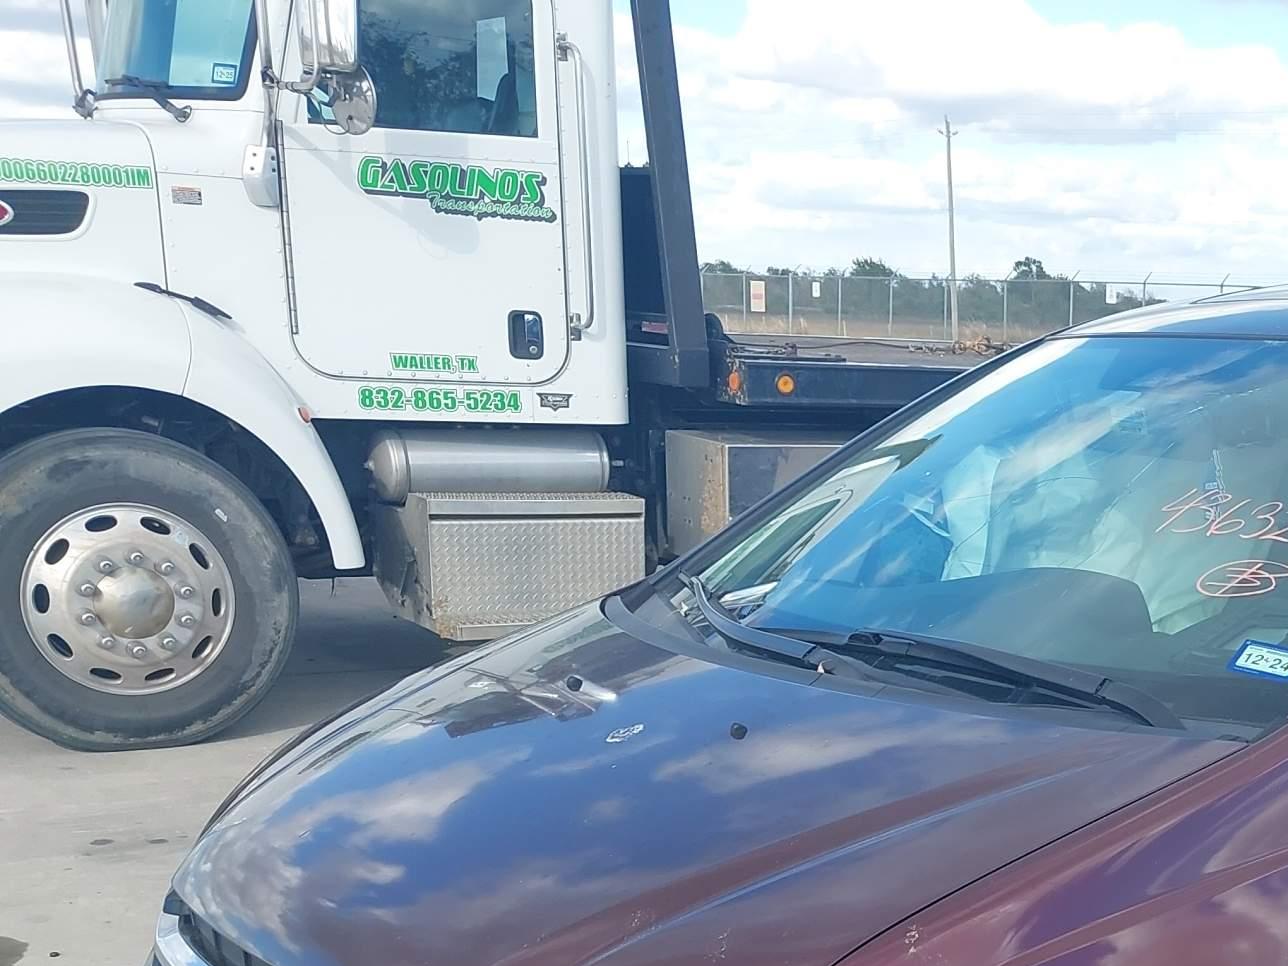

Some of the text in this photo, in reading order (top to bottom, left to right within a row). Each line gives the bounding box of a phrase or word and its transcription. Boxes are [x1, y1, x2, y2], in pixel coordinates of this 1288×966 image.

[0, 159, 151, 187] 006602280001IM
[359, 157, 546, 204] GASOLINO'S
[427, 191, 552, 219] Transportation
[392, 354, 478, 373] WALLER, TX
[359, 387, 521, 412] 832-865-5234
